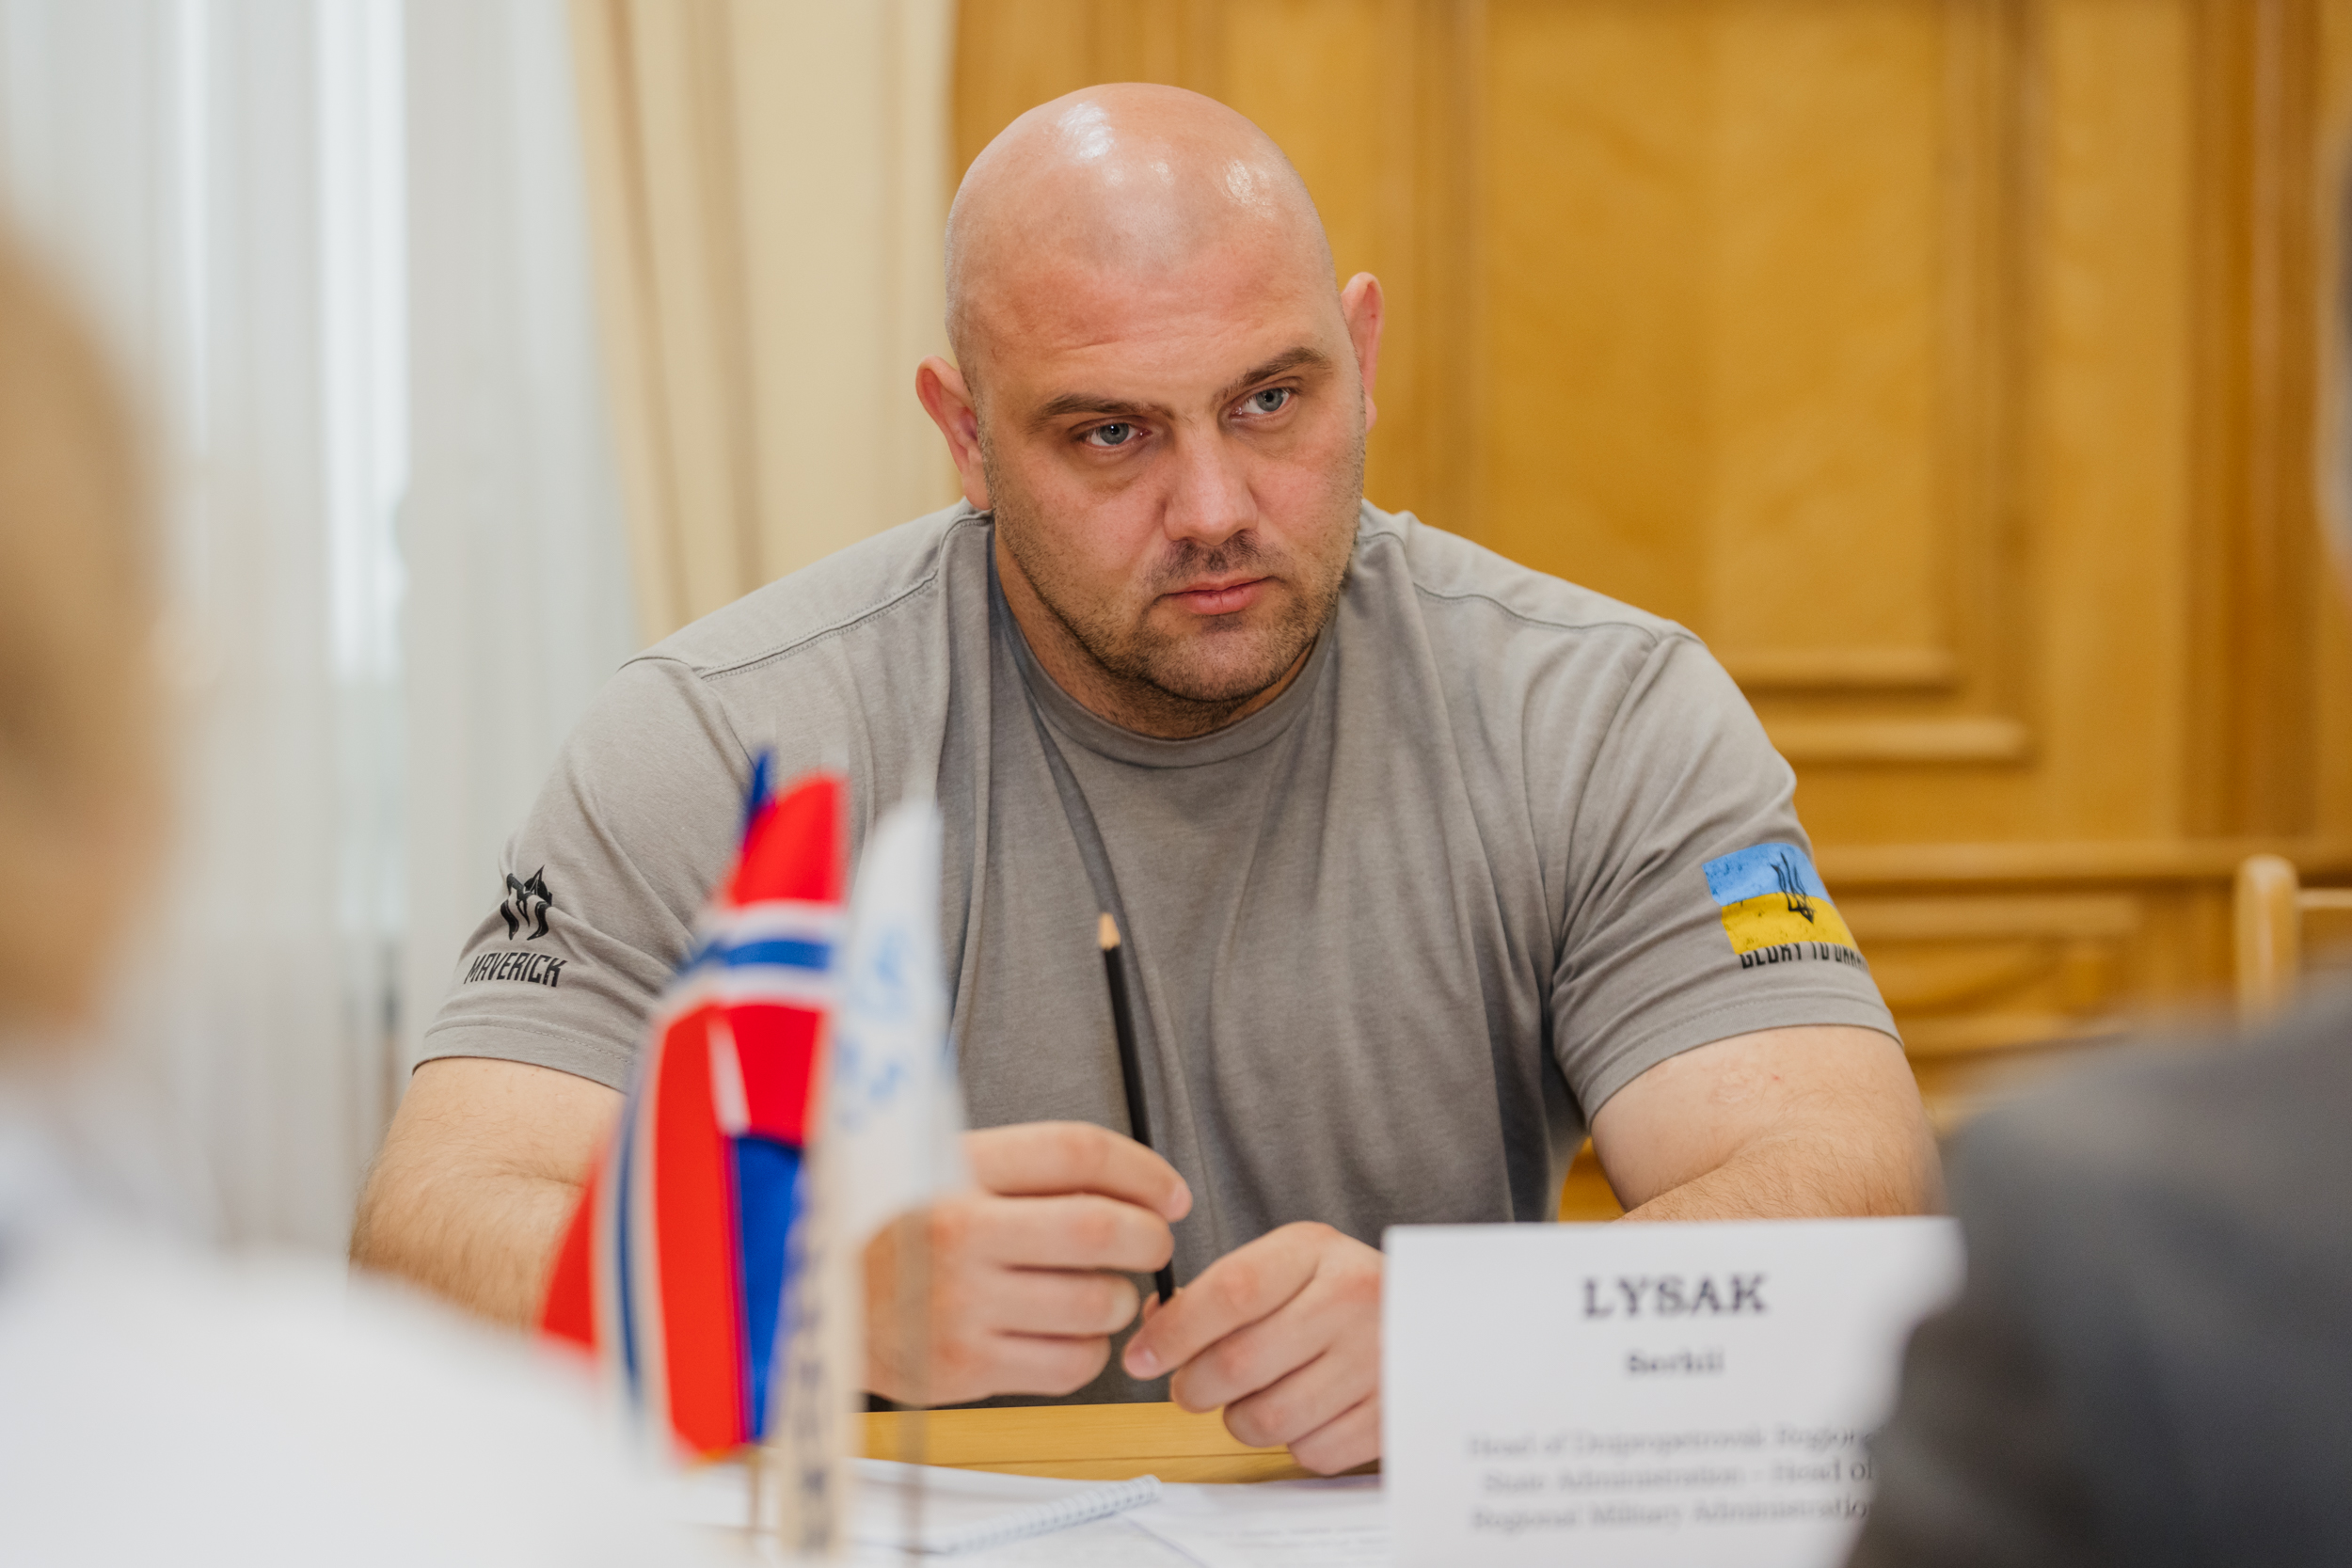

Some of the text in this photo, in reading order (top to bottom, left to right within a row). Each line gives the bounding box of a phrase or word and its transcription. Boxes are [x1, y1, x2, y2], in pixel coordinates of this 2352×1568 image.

[464, 952, 568, 988] MAVERICK
[1581, 1274, 1769, 1318] LYSAK
[1693, 1493, 1867, 1527] Administratio
